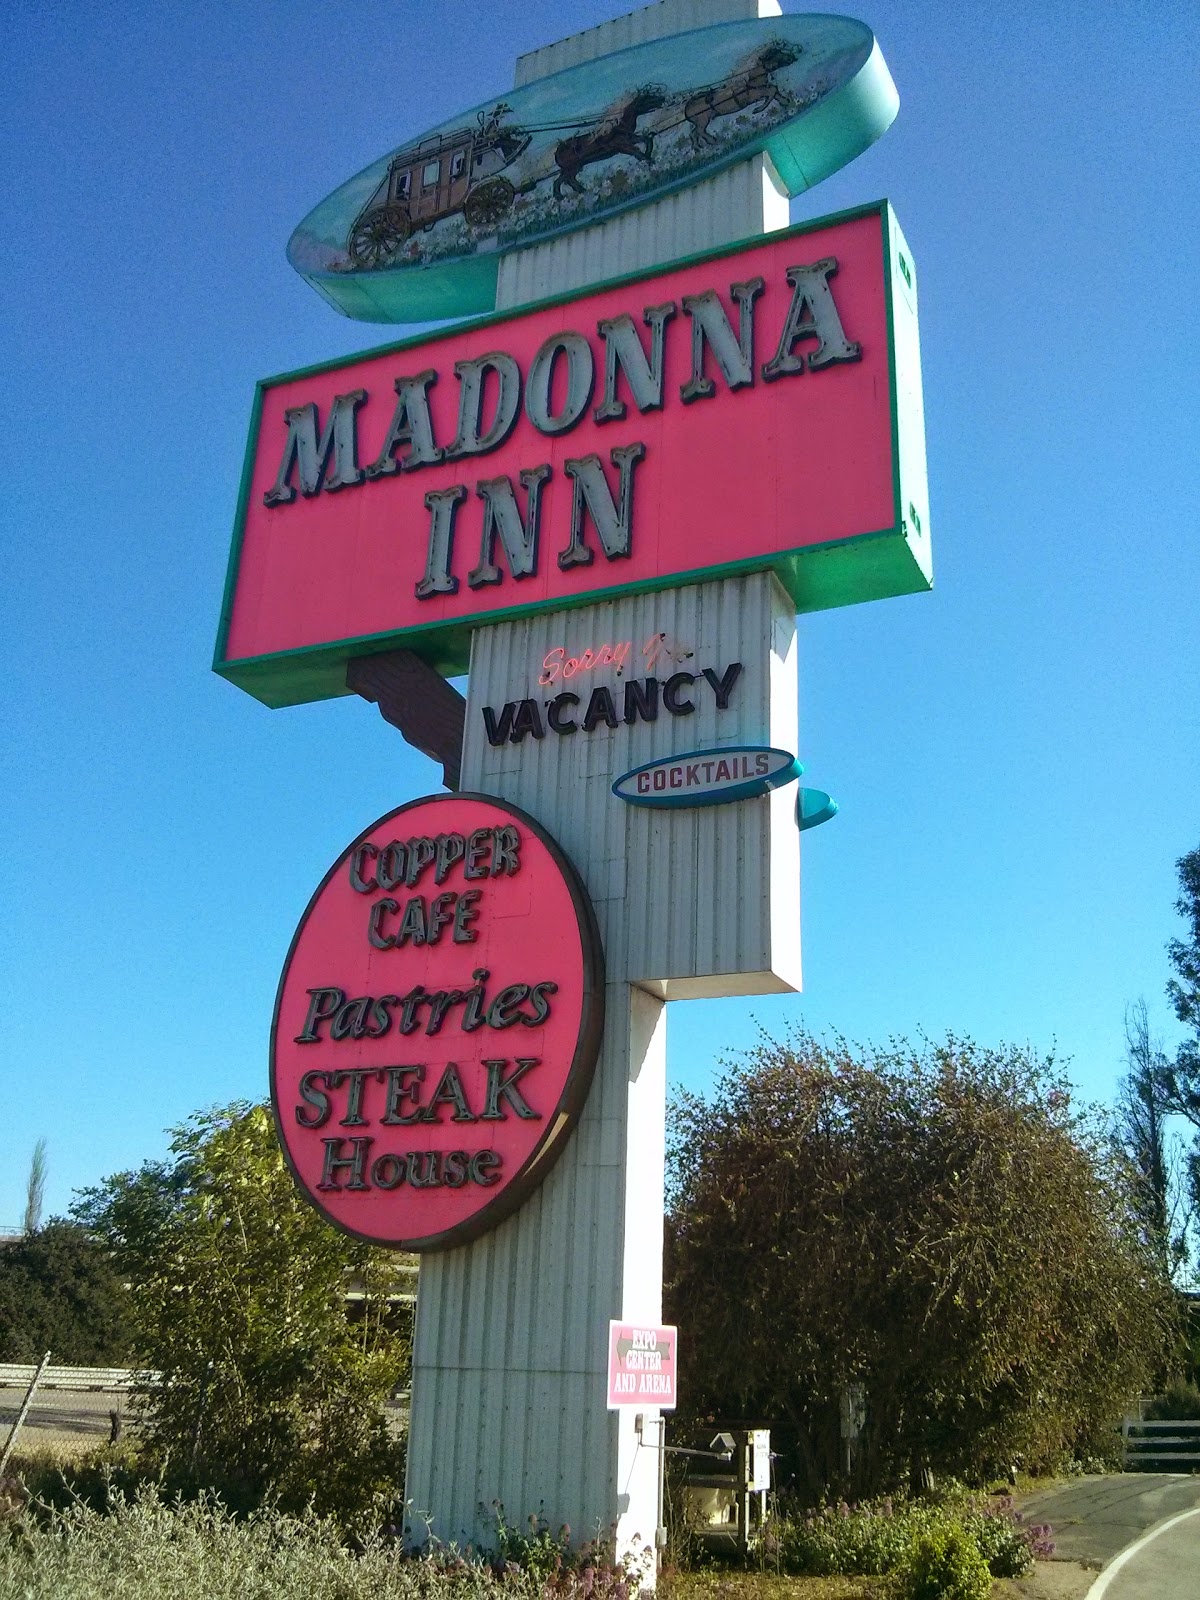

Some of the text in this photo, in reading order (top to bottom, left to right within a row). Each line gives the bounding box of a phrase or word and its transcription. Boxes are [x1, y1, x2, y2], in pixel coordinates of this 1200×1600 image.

[263, 257, 861, 507] MADONNA
[414, 442, 646, 600] INN
[538, 640, 632, 686] Sorry
[481, 662, 743, 747] VACANCY
[637, 753, 769, 794] COCKTAILS
[349, 825, 521, 894] COPPER
[368, 889, 480, 949] CAFE
[294, 968, 558, 1044] Pastries
[295, 1057, 542, 1129] STEAK
[315, 1136, 503, 1192] House
[626, 1350, 662, 1370] CENTER
[632, 1329, 657, 1350] EXPO
[613, 1372, 672, 1394] AND ARENA
